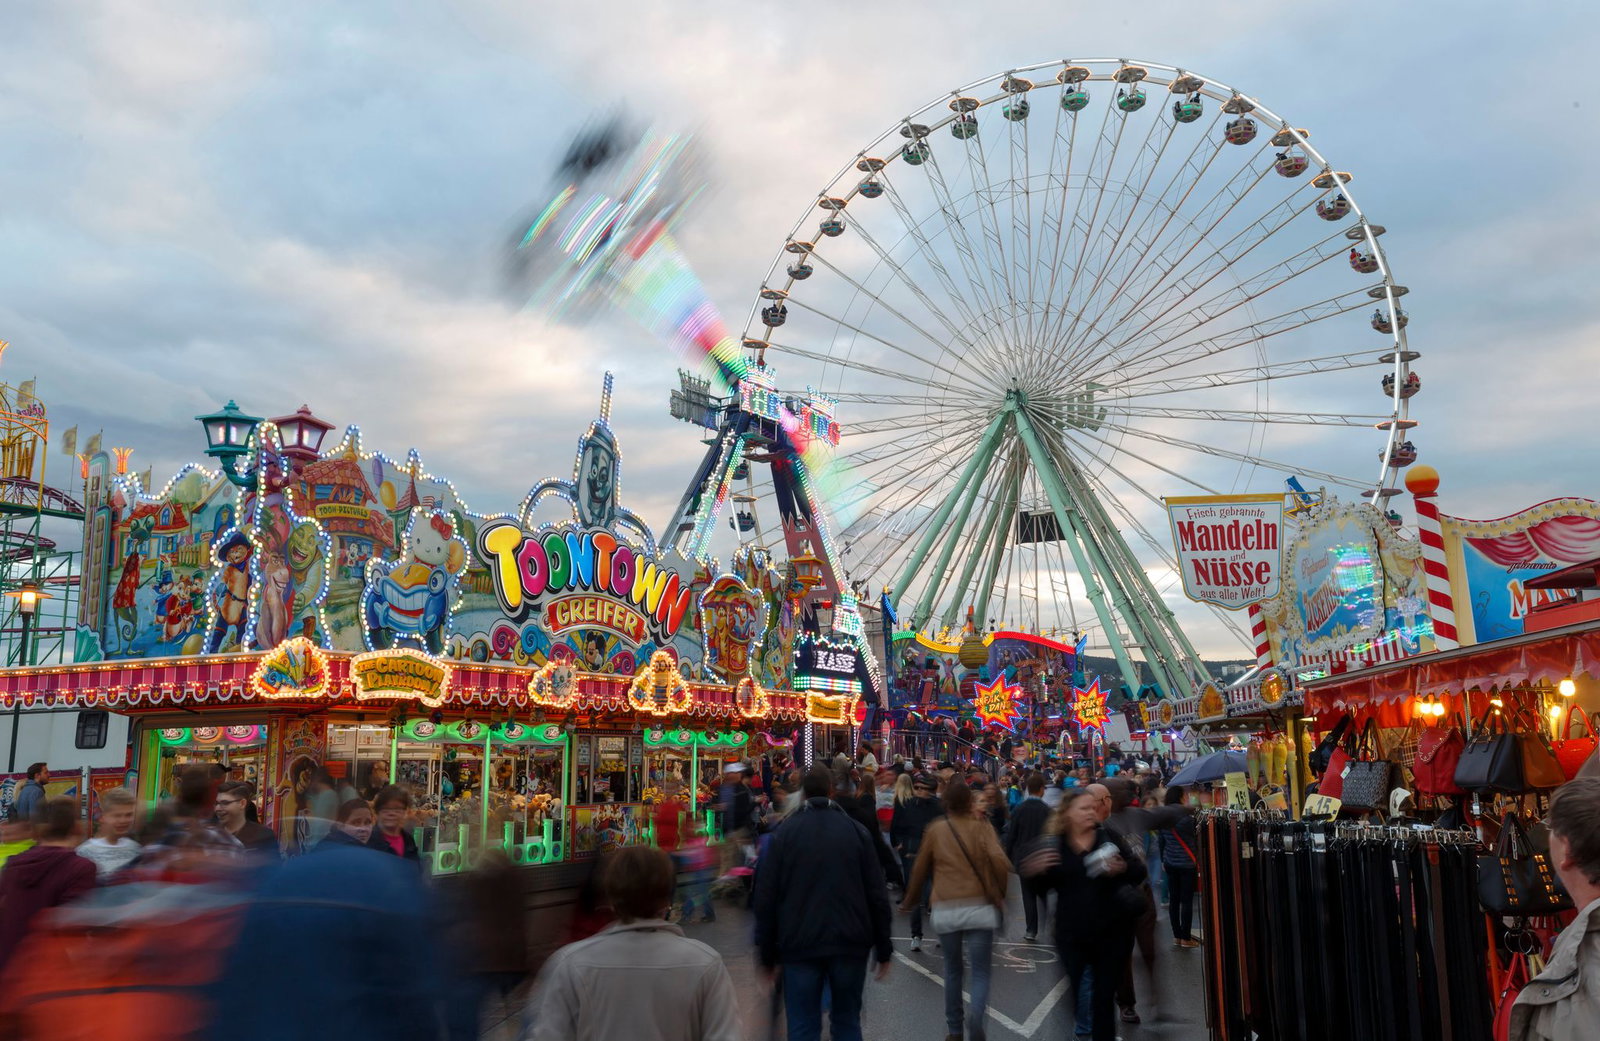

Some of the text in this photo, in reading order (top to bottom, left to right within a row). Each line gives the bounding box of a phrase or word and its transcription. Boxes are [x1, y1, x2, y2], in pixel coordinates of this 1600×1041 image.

[1186, 506, 1265, 520] Frisch gebrannte
[1176, 518, 1278, 551] Mandeln
[1230, 550, 1246, 561] und
[484, 525, 692, 636] TOONTOWN
[1191, 558, 1271, 587] Nüsse
[1200, 586, 1266, 600] aus aller Welt!
[556, 597, 639, 637] GREIFER
[375, 656, 445, 683] CARTOON
